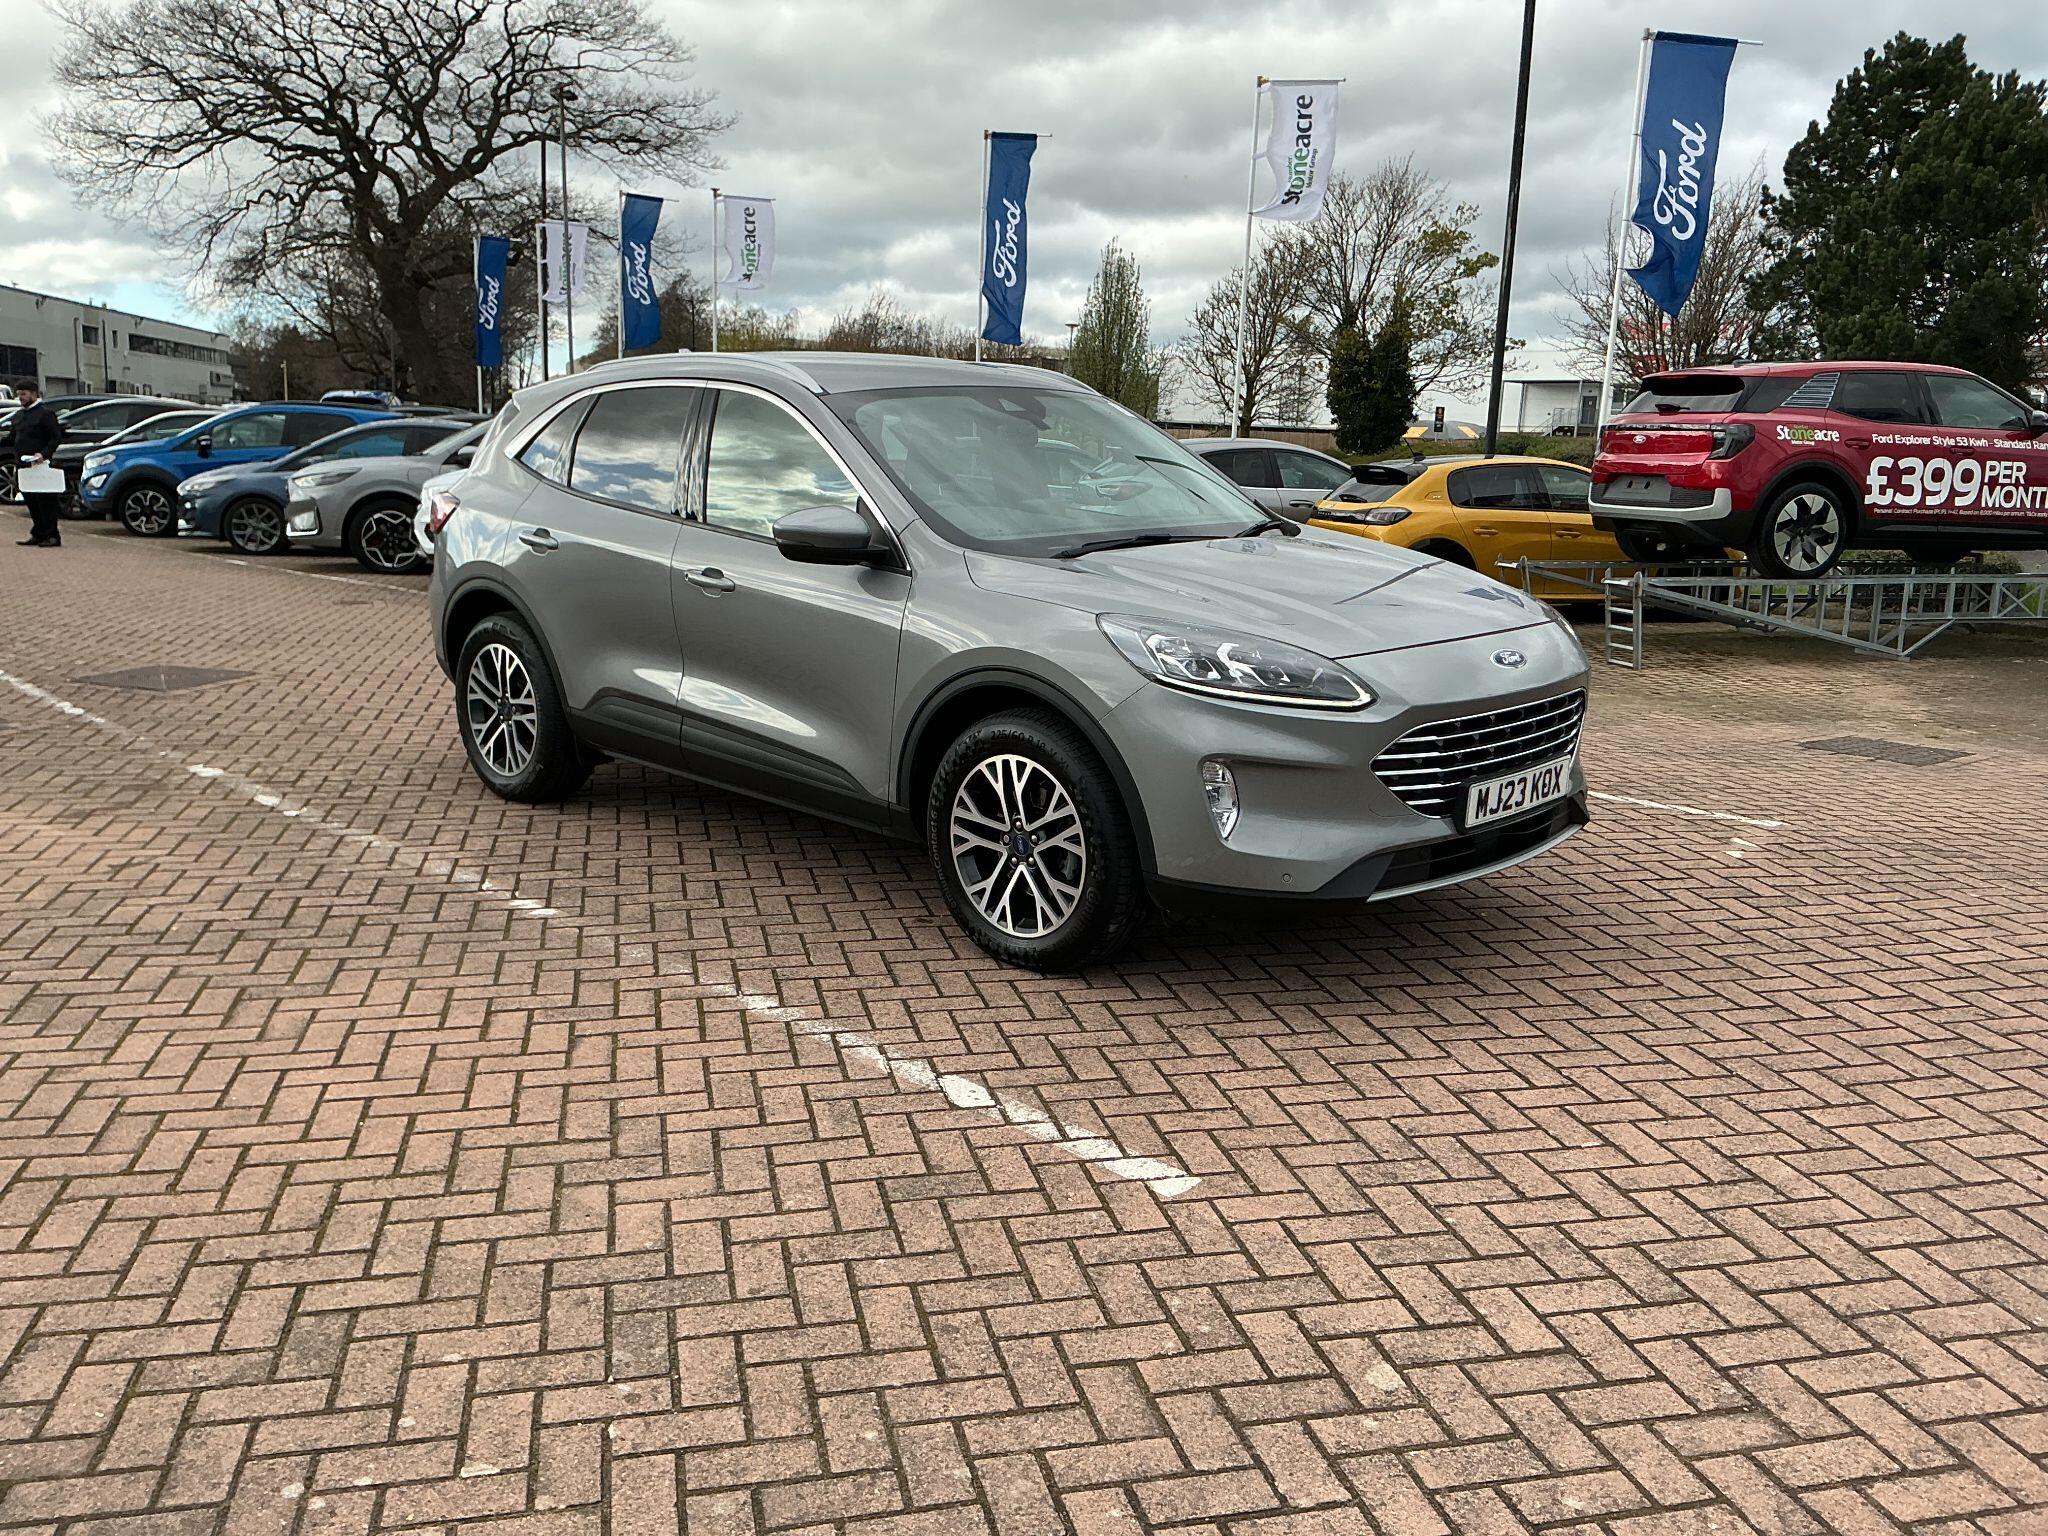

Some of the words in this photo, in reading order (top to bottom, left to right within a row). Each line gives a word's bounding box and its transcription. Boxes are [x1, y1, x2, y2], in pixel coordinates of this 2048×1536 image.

[1282, 95, 1313, 205] Stoneacre
[1654, 119, 1707, 241] Ford
[993, 198, 1021, 288] Ford
[625, 241, 651, 305] Ford
[478, 275, 500, 331] Ford
[1776, 425, 1840, 442] Stoneacre
[1872, 434, 1893, 443] Ford
[1895, 435, 1931, 445] Explorer
[1932, 436, 1955, 447] Style
[1956, 436, 1968, 446] 53
[1969, 437, 1989, 447] Kwh
[1994, 438, 2031, 449] Standard
[1864, 456, 1982, 507] £399
[1981, 485, 2048, 509] MONT
[1984, 460, 2027, 485] PER
[1499, 651, 1521, 664] Ford
[1475, 777, 1528, 819] MJ23
[1530, 764, 1563, 803] KOX
